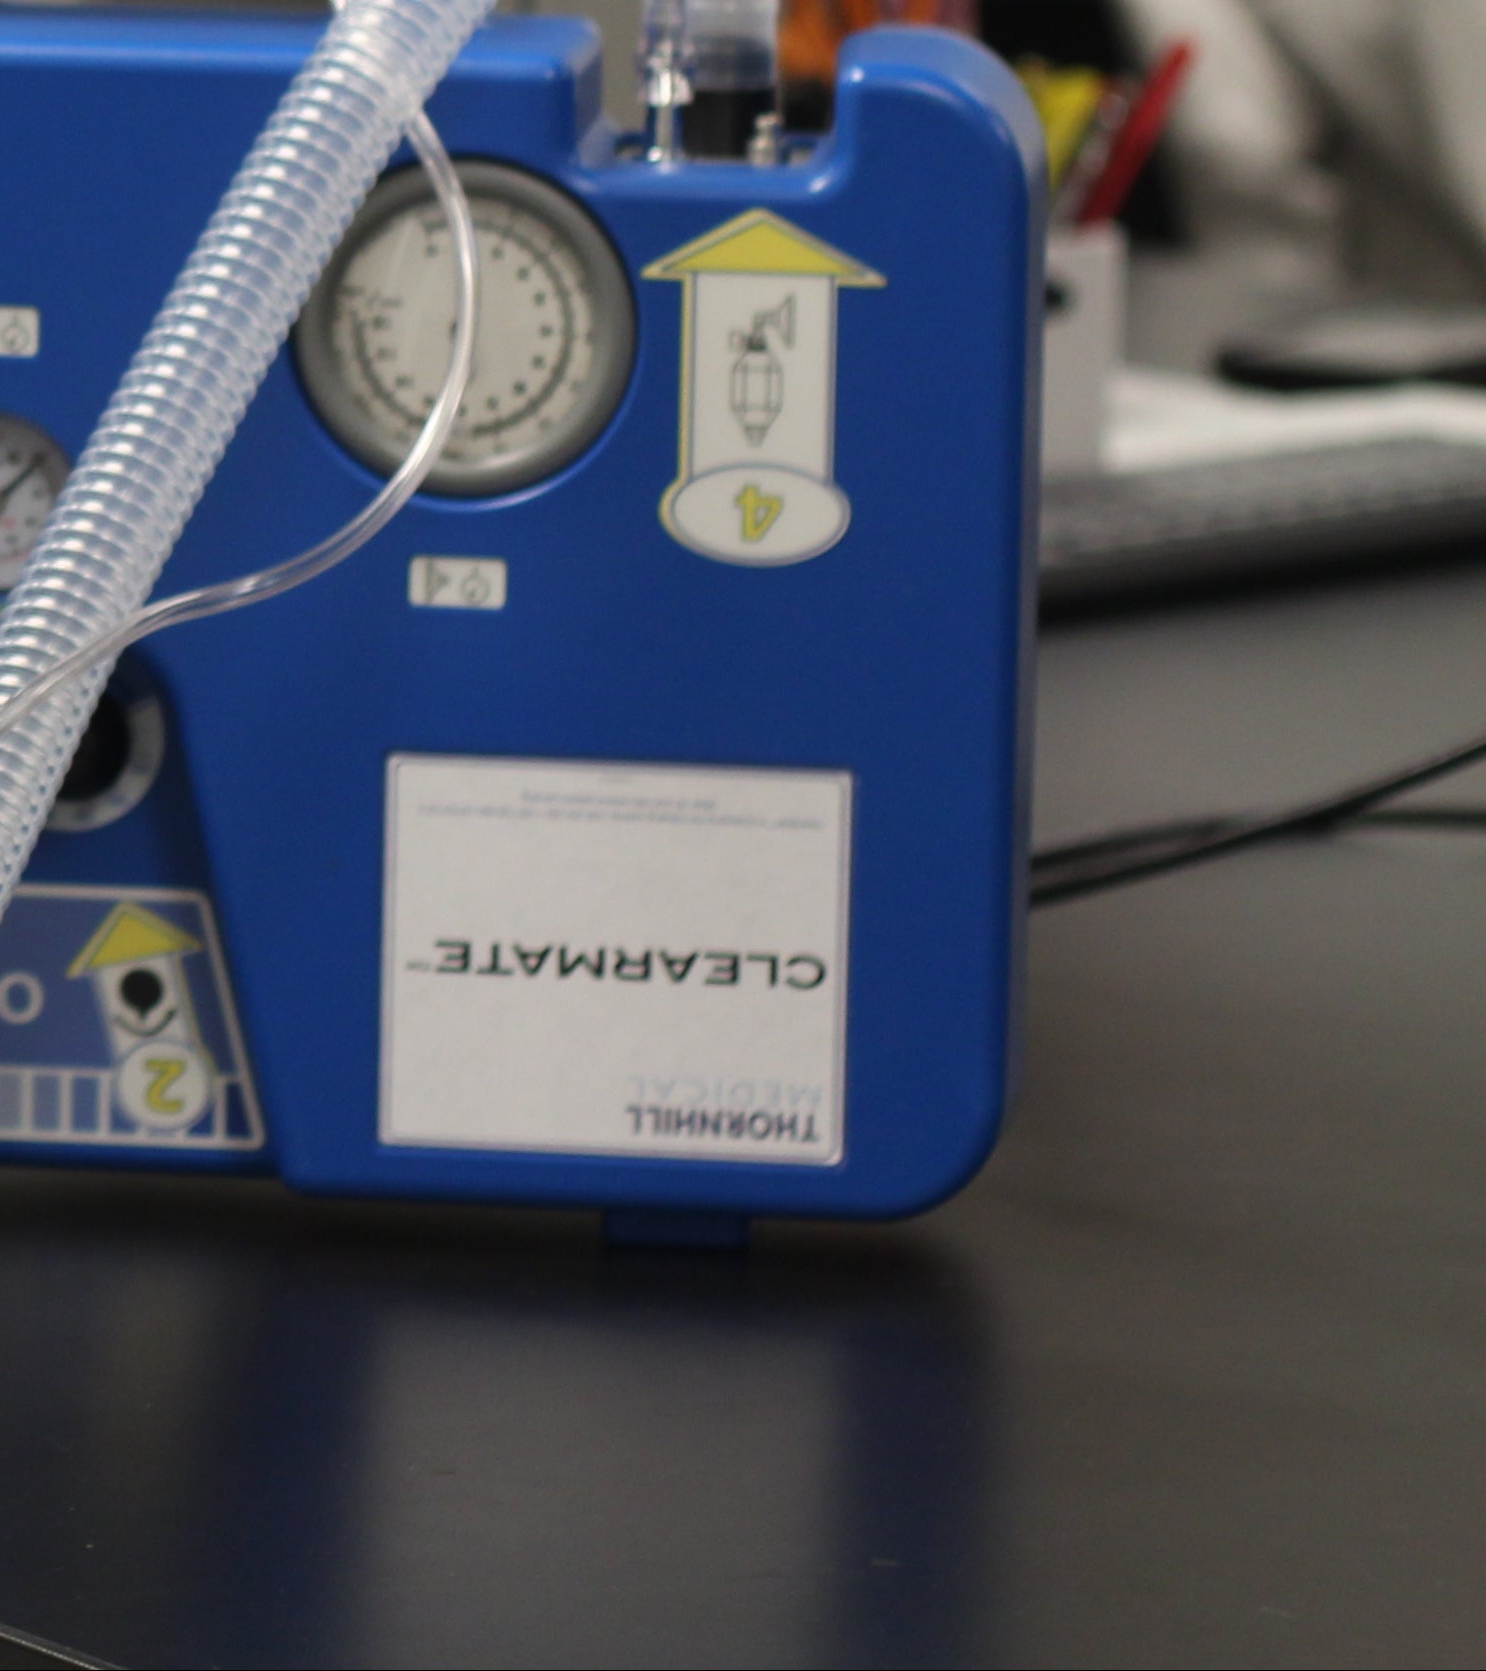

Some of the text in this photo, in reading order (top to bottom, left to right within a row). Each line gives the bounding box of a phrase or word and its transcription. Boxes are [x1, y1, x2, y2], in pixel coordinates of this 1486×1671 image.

[735, 483, 784, 543] 4
[142, 1058, 187, 1114] 2
[627, 1075, 823, 1107] MEDICAL
[625, 1105, 821, 1144] THORNHILL
